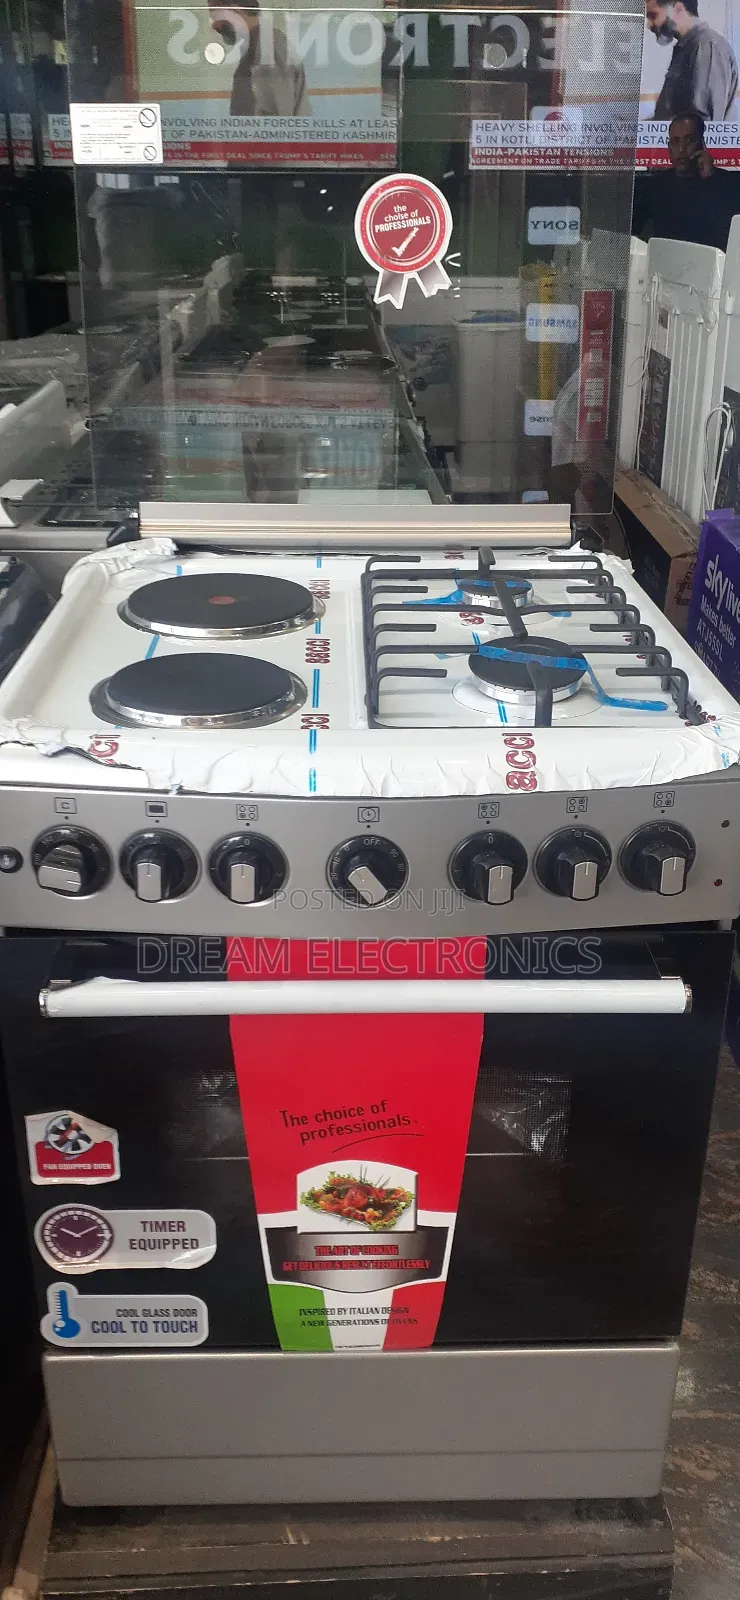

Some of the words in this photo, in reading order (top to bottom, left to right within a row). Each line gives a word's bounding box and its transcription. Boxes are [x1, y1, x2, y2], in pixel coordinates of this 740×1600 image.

[221, 118, 260, 128] INDIAN
[263, 118, 309, 128] FORCES
[314, 119, 346, 128] KILLS
[350, 119, 364, 128] AT
[475, 123, 514, 132] HEAVY
[343, 131, 396, 140] KASHMIR
[486, 135, 498, 144] IN
[475, 148, 560, 156] INDIA-PAKISTAN
[393, 205, 407, 213] the
[410, 209, 419, 218] of
[375, 216, 431, 232] PROFESSIONALS
[280, 1110, 309, 1127] The
[315, 1106, 365, 1122] choice
[370, 1100, 388, 1114] of
[141, 1221, 186, 1232] TIMER
[129, 1239, 199, 1250] EQUIPPED
[315, 1245, 331, 1256] THE
[116, 1309, 139, 1318] COOL
[142, 1309, 170, 1318] GLASS
[173, 1309, 197, 1318] DOOR
[300, 1307, 336, 1316] INSPIRED
[337, 1307, 347, 1315] BY
[349, 1307, 380, 1315] ITALIAN
[91, 1321, 126, 1333] COOL
[130, 1321, 148, 1333] TO
[153, 1321, 198, 1333] TOUCH
[327, 1319, 379, 1327] GENERATIONS
